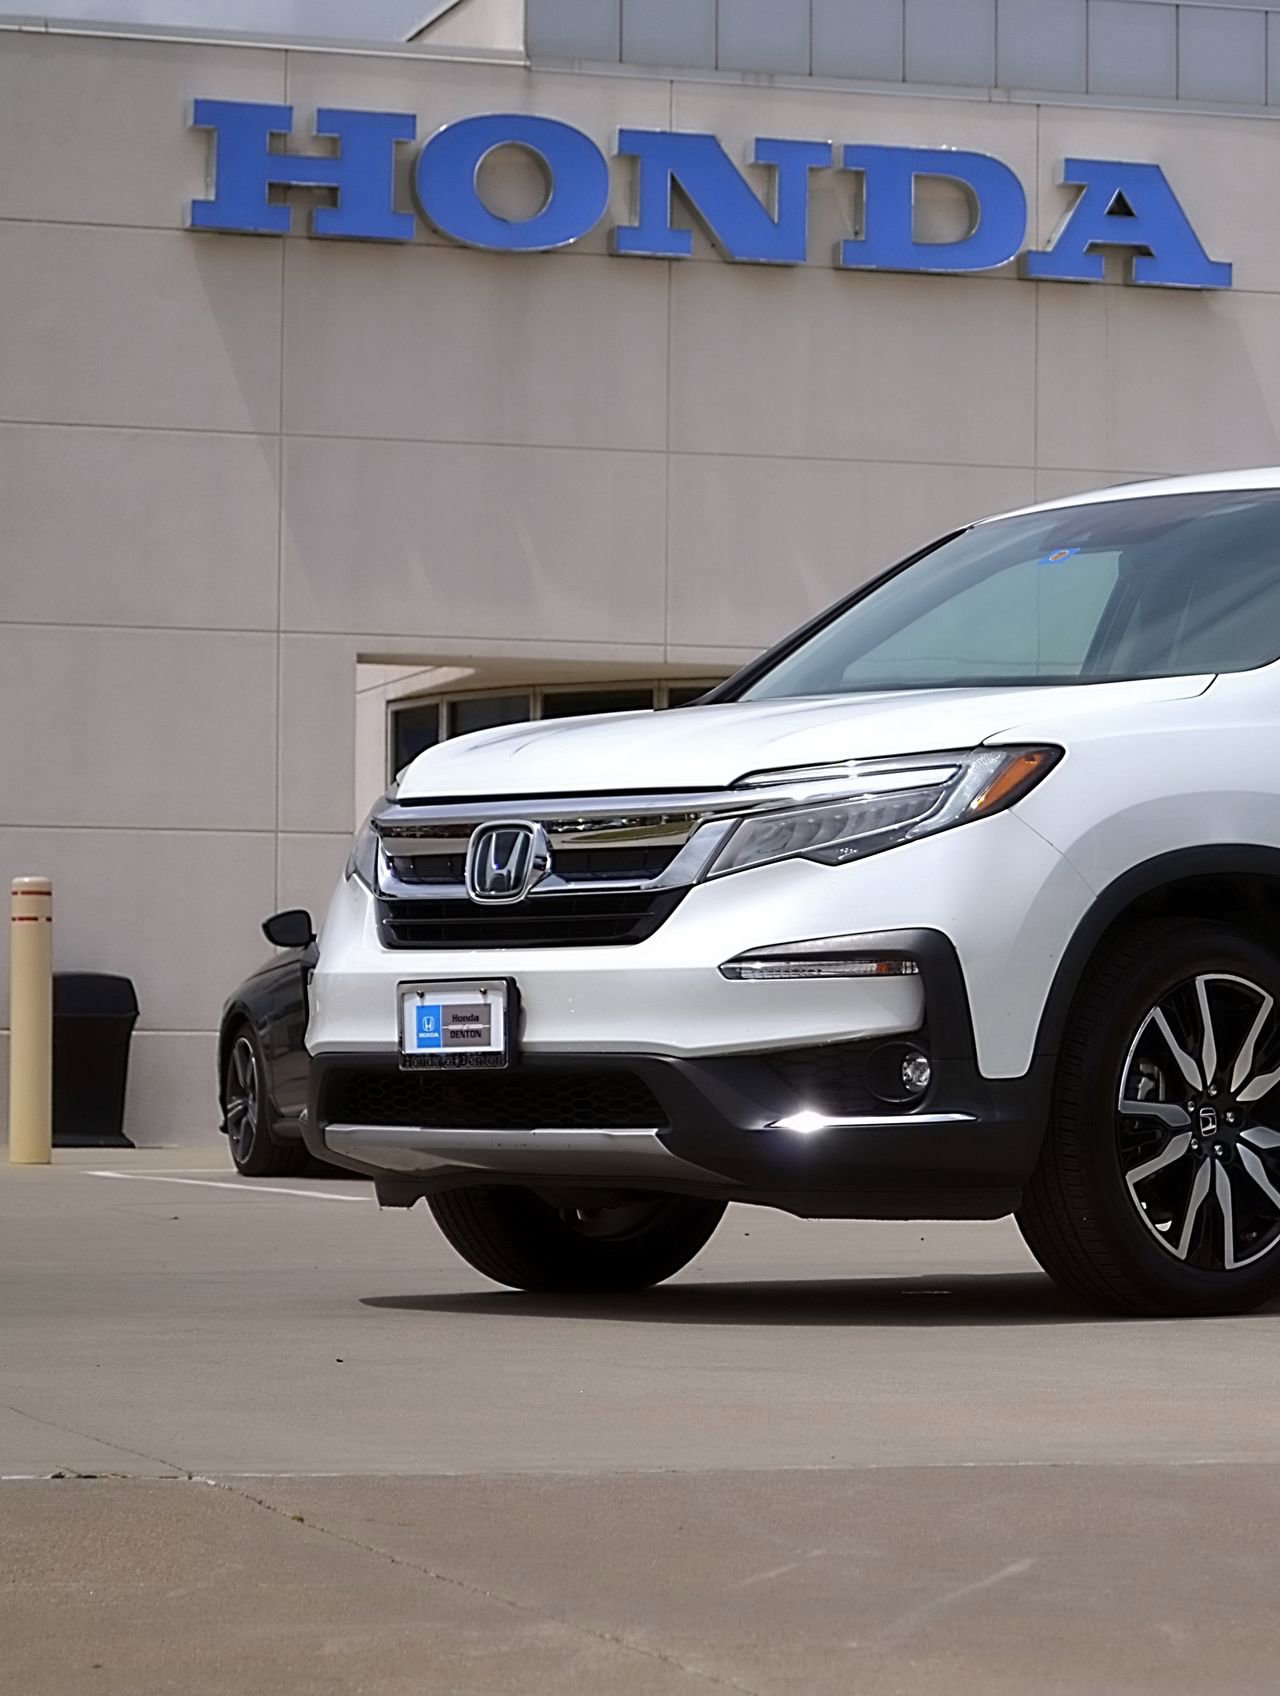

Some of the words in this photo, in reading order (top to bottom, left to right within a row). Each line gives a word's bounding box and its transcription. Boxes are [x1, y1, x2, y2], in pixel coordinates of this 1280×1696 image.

[190, 98, 1233, 290] HONDA
[451, 1013, 480, 1022] Honda
[450, 1030, 482, 1038] DENTON
[404, 1055, 442, 1068] Honda
[460, 1053, 505, 1066] Denton
